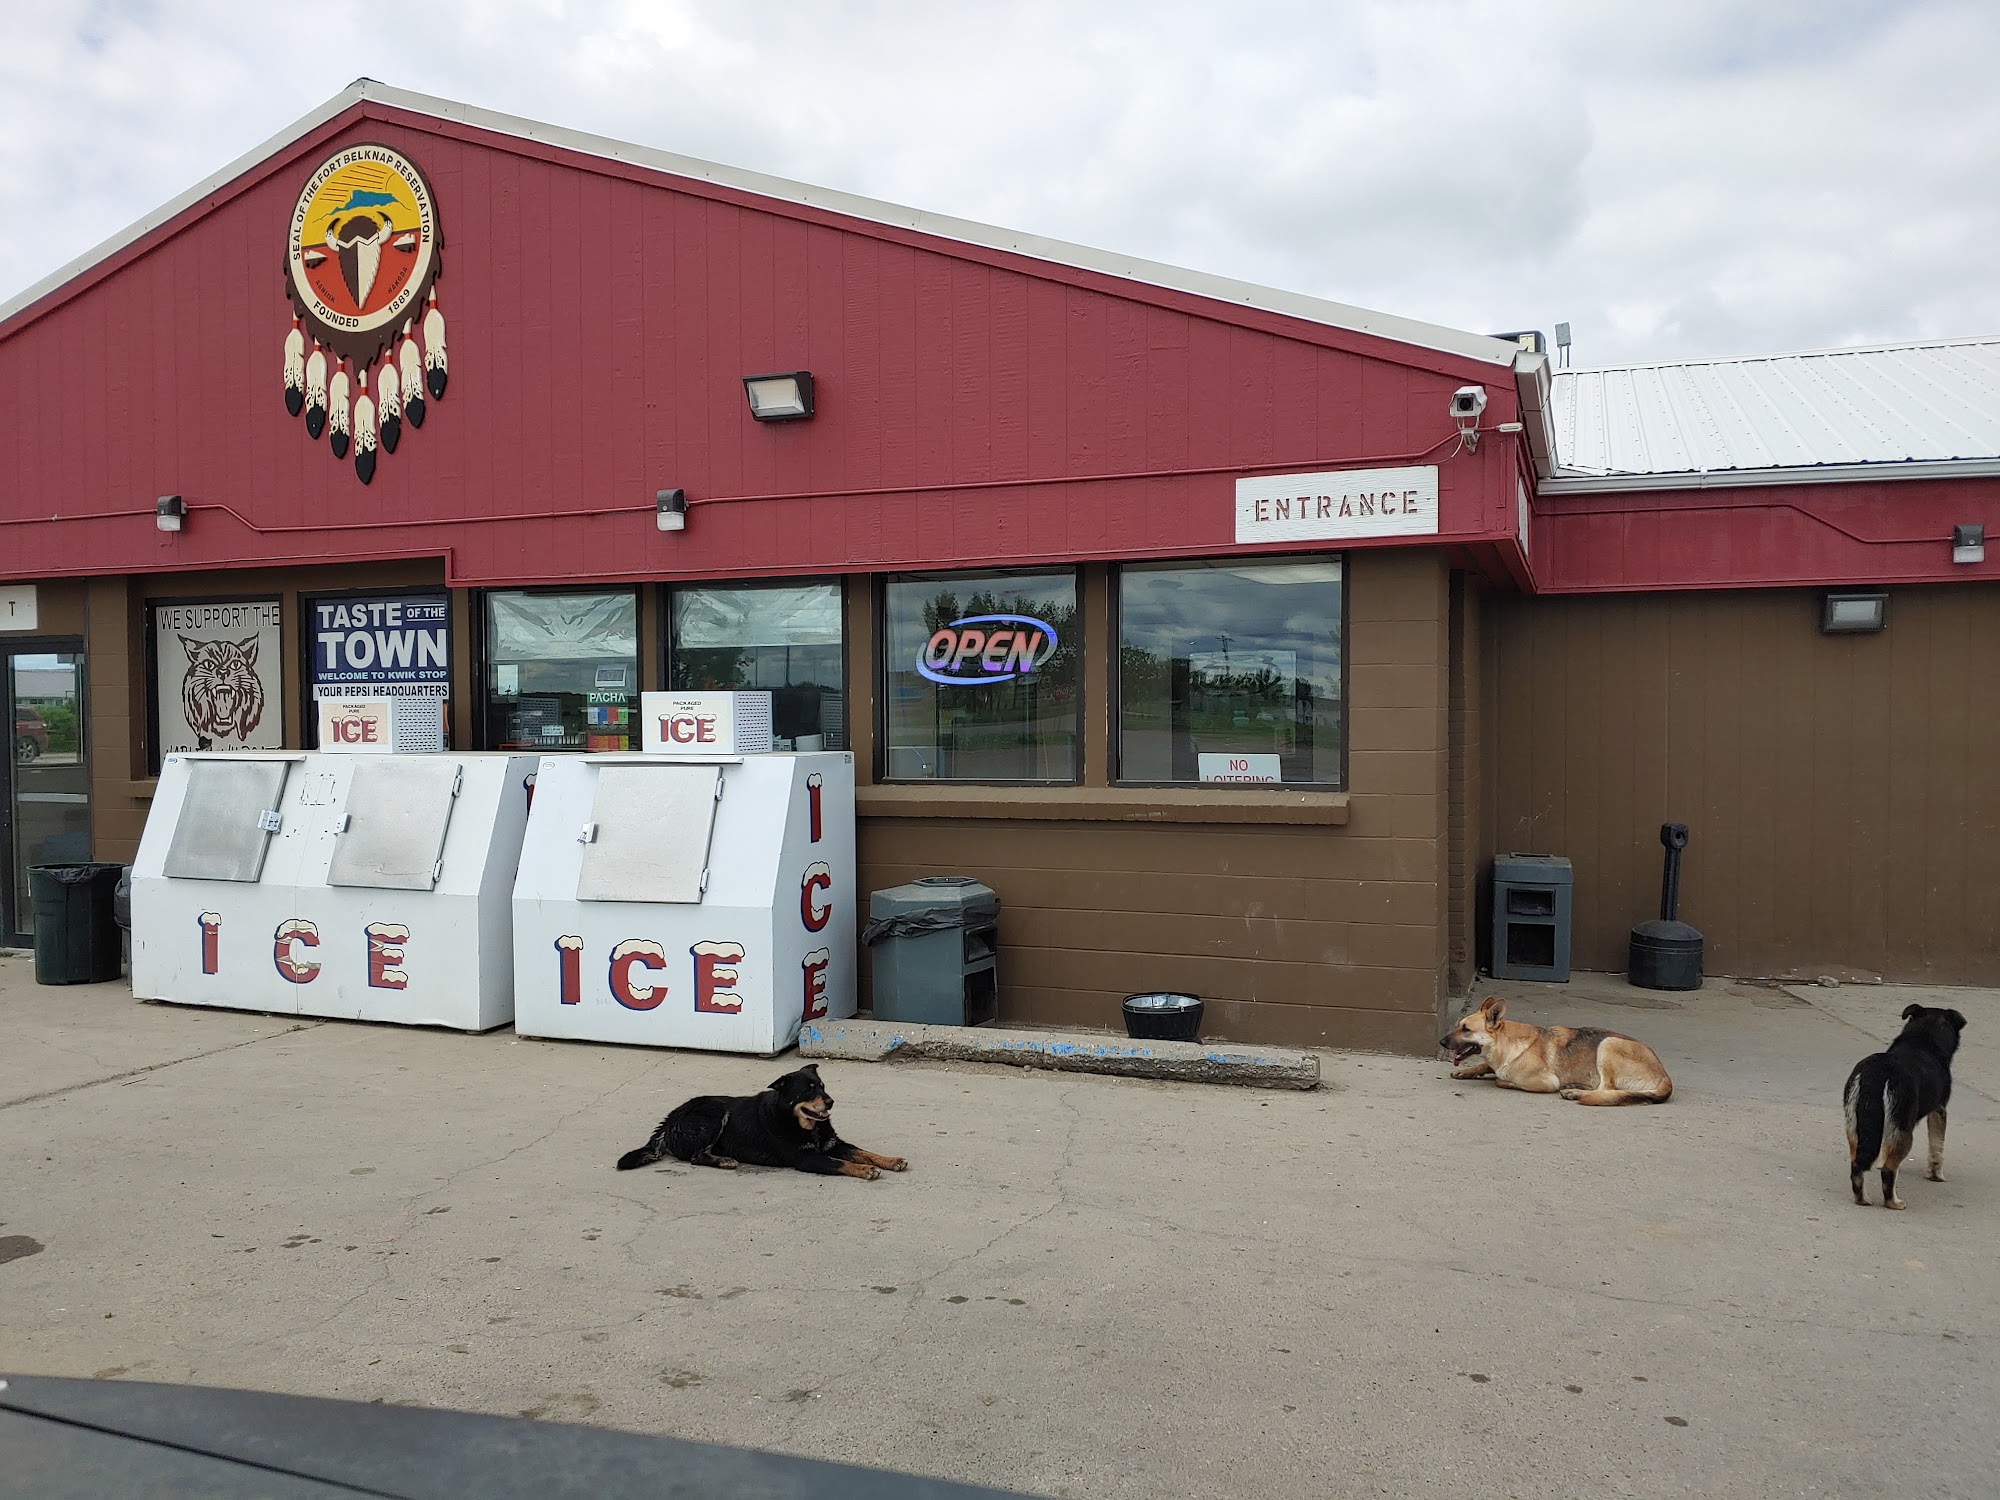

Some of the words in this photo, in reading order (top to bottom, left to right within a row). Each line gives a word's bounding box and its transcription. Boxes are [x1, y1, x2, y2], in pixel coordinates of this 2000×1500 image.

[318, 158, 342, 184] FORT
[343, 150, 394, 165] BELKNAP
[302, 183, 320, 205] THE
[393, 159, 431, 243] RESERVATION
[297, 205, 308, 223] OF
[293, 226, 302, 261] SEAL
[387, 266, 408, 294] NAKODA
[313, 300, 359, 328] FOUNDED
[387, 288, 411, 314] 1889
[1255, 490, 1418, 522] ENTRANCE
[160, 608, 181, 631] WE
[185, 606, 249, 630] SUPPORT
[253, 605, 280, 627] THE
[317, 602, 402, 629] TASTE
[406, 607, 421, 618] OF
[423, 606, 446, 618] THE
[317, 628, 448, 669] TOWN
[925, 629, 1043, 673] OPEN
[318, 672, 369, 681] WELCOME
[371, 671, 385, 680] TO
[388, 670, 416, 680] KWIK
[418, 670, 447, 679] STOP
[318, 686, 343, 697] YOUR
[345, 686, 370, 697] PEPSI
[373, 685, 448, 697] HEADQUARTERS
[589, 692, 626, 703] PACHA
[331, 714, 379, 743] ICE
[658, 712, 718, 743] ICE
[1229, 759, 1248, 771] NO
[801, 772, 832, 1023] ICE
[197, 911, 410, 990] ICE
[554, 934, 745, 1015] ICE
